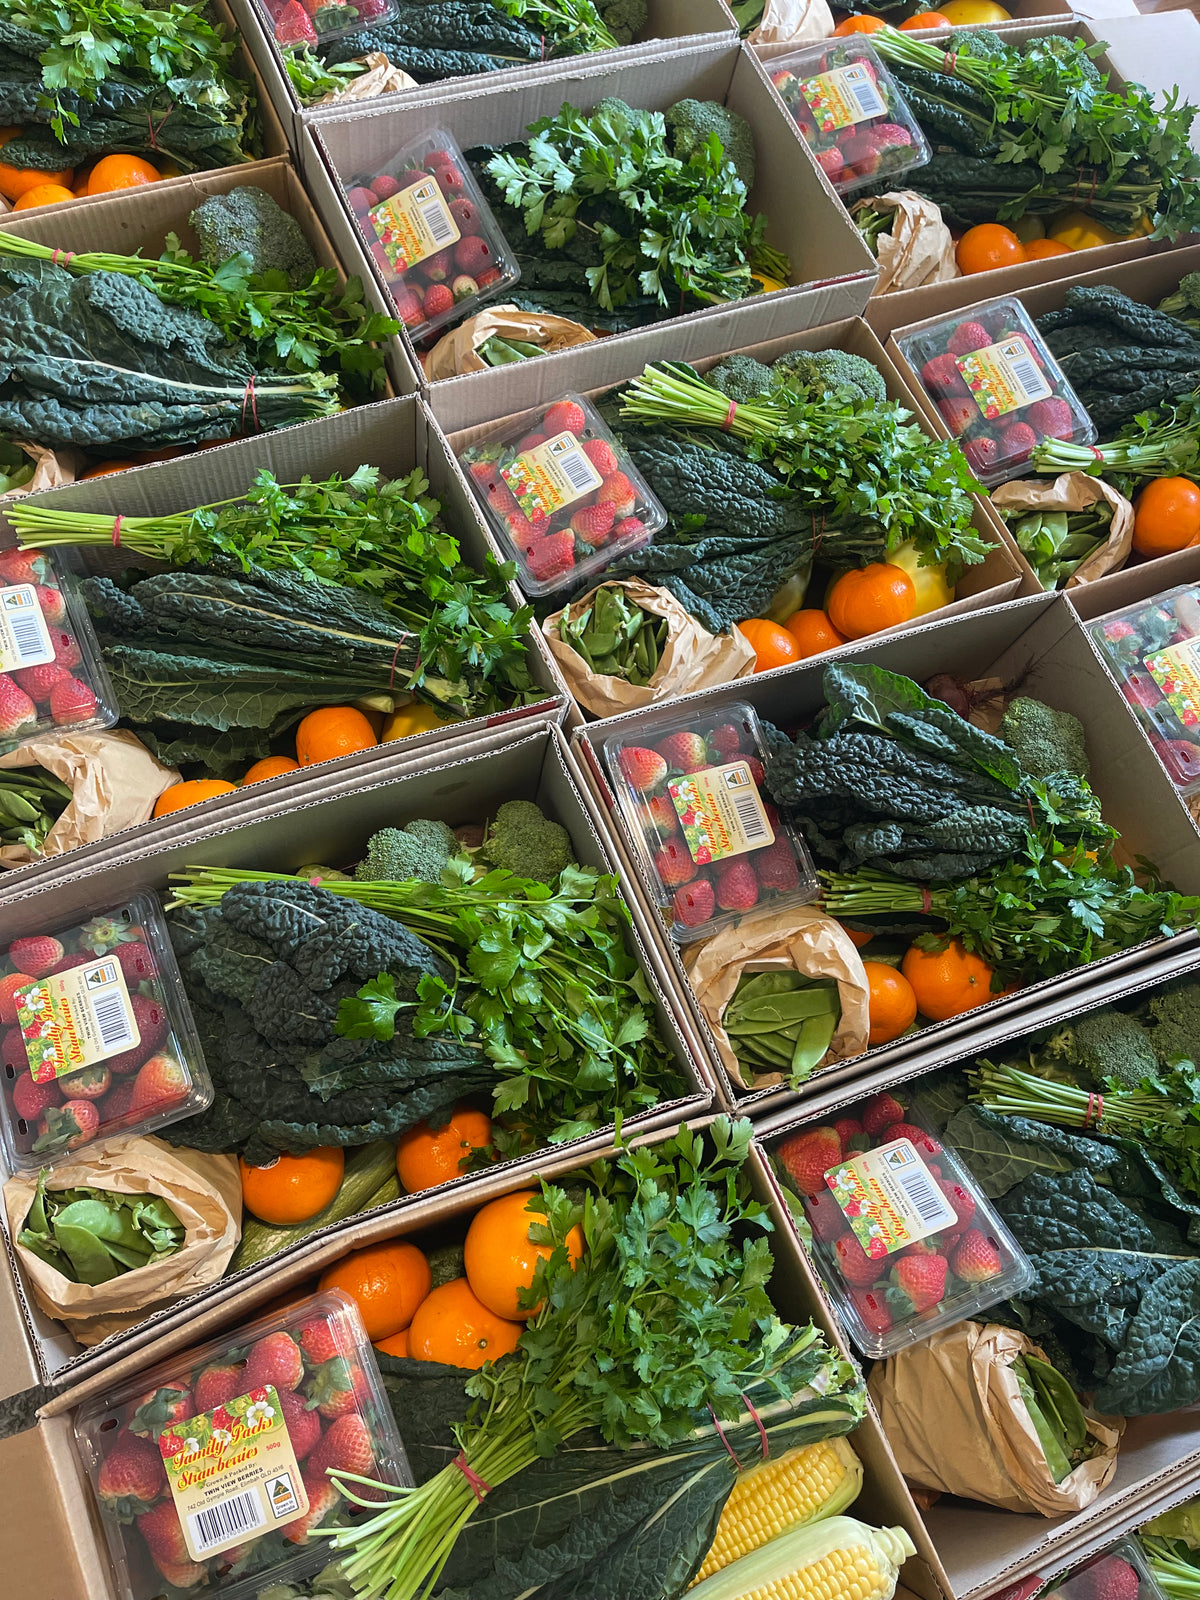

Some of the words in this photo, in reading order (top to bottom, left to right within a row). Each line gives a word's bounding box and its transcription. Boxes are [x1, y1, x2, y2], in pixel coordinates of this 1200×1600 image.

[37, 988, 55, 1020] Packs
[59, 997, 83, 1062] Strawberries
[46, 1025, 66, 1068] Family
[846, 1169, 870, 1199] Packs
[866, 1204, 895, 1244] Family
[868, 1177, 909, 1238] Strawberries
[173, 1437, 224, 1470] Family
[231, 1416, 272, 1445] Packs
[265, 1441, 281, 1451] 500g
[177, 1447, 258, 1490] Strawberries
[204, 1486, 219, 1496] TWIN
[220, 1478, 236, 1489] VIEW
[237, 1466, 263, 1481] BERRIES
[205, 1475, 223, 1487] Grown
[228, 1464, 247, 1477] Packed
[205, 1490, 225, 1503] Gympie
[240, 1475, 259, 1487] Elimbah
[260, 1469, 271, 1478] QLD
[275, 1501, 288, 1510] Grown
[276, 1504, 295, 1515] Australia
